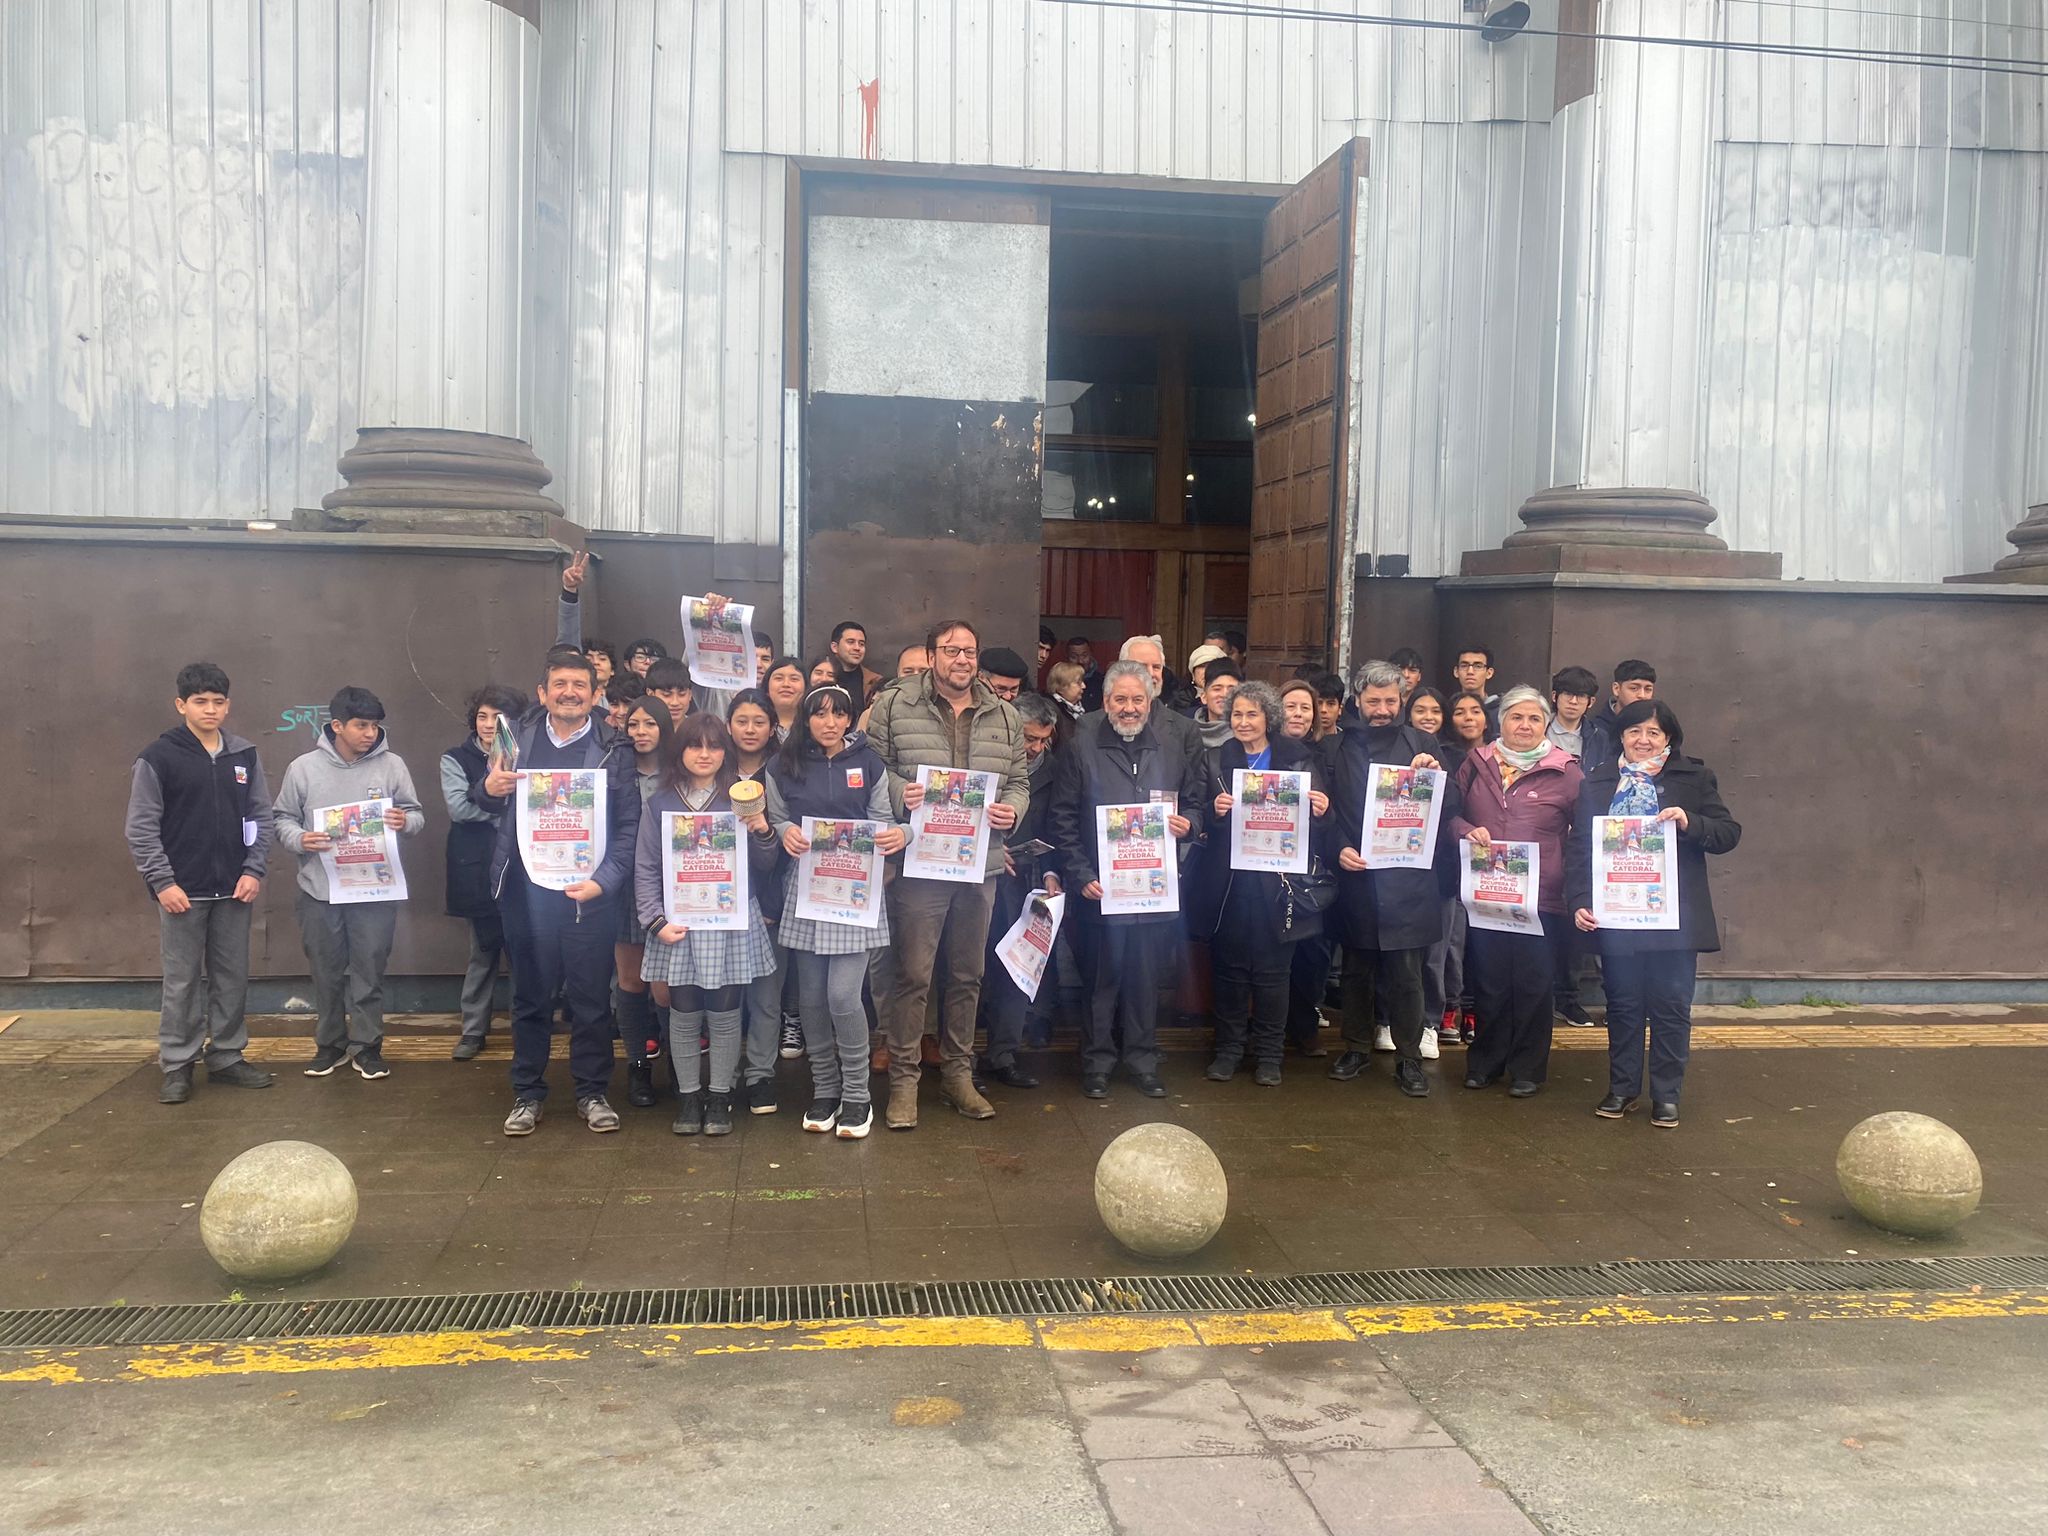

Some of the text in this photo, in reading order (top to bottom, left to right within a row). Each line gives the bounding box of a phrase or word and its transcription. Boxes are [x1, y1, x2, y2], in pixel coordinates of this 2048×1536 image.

[931, 817, 971, 825] CATEDRAL
[820, 862, 862, 870] CATEDRAL
[1480, 885, 1518, 893] CATEDRAL
